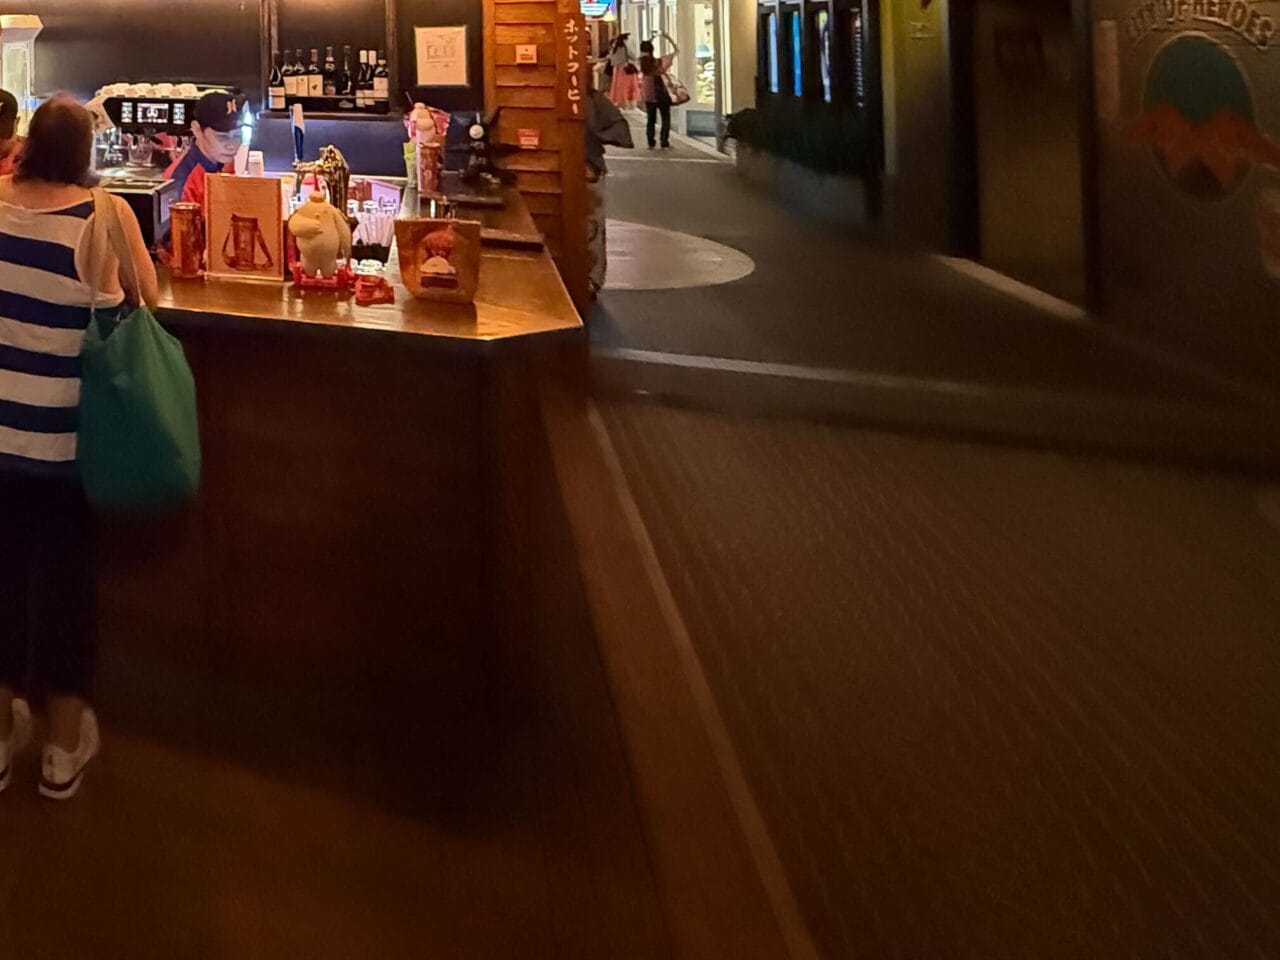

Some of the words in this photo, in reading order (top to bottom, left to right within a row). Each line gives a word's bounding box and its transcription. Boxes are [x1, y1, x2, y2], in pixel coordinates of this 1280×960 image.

[563, 18, 581, 115] ホットコーヒー
